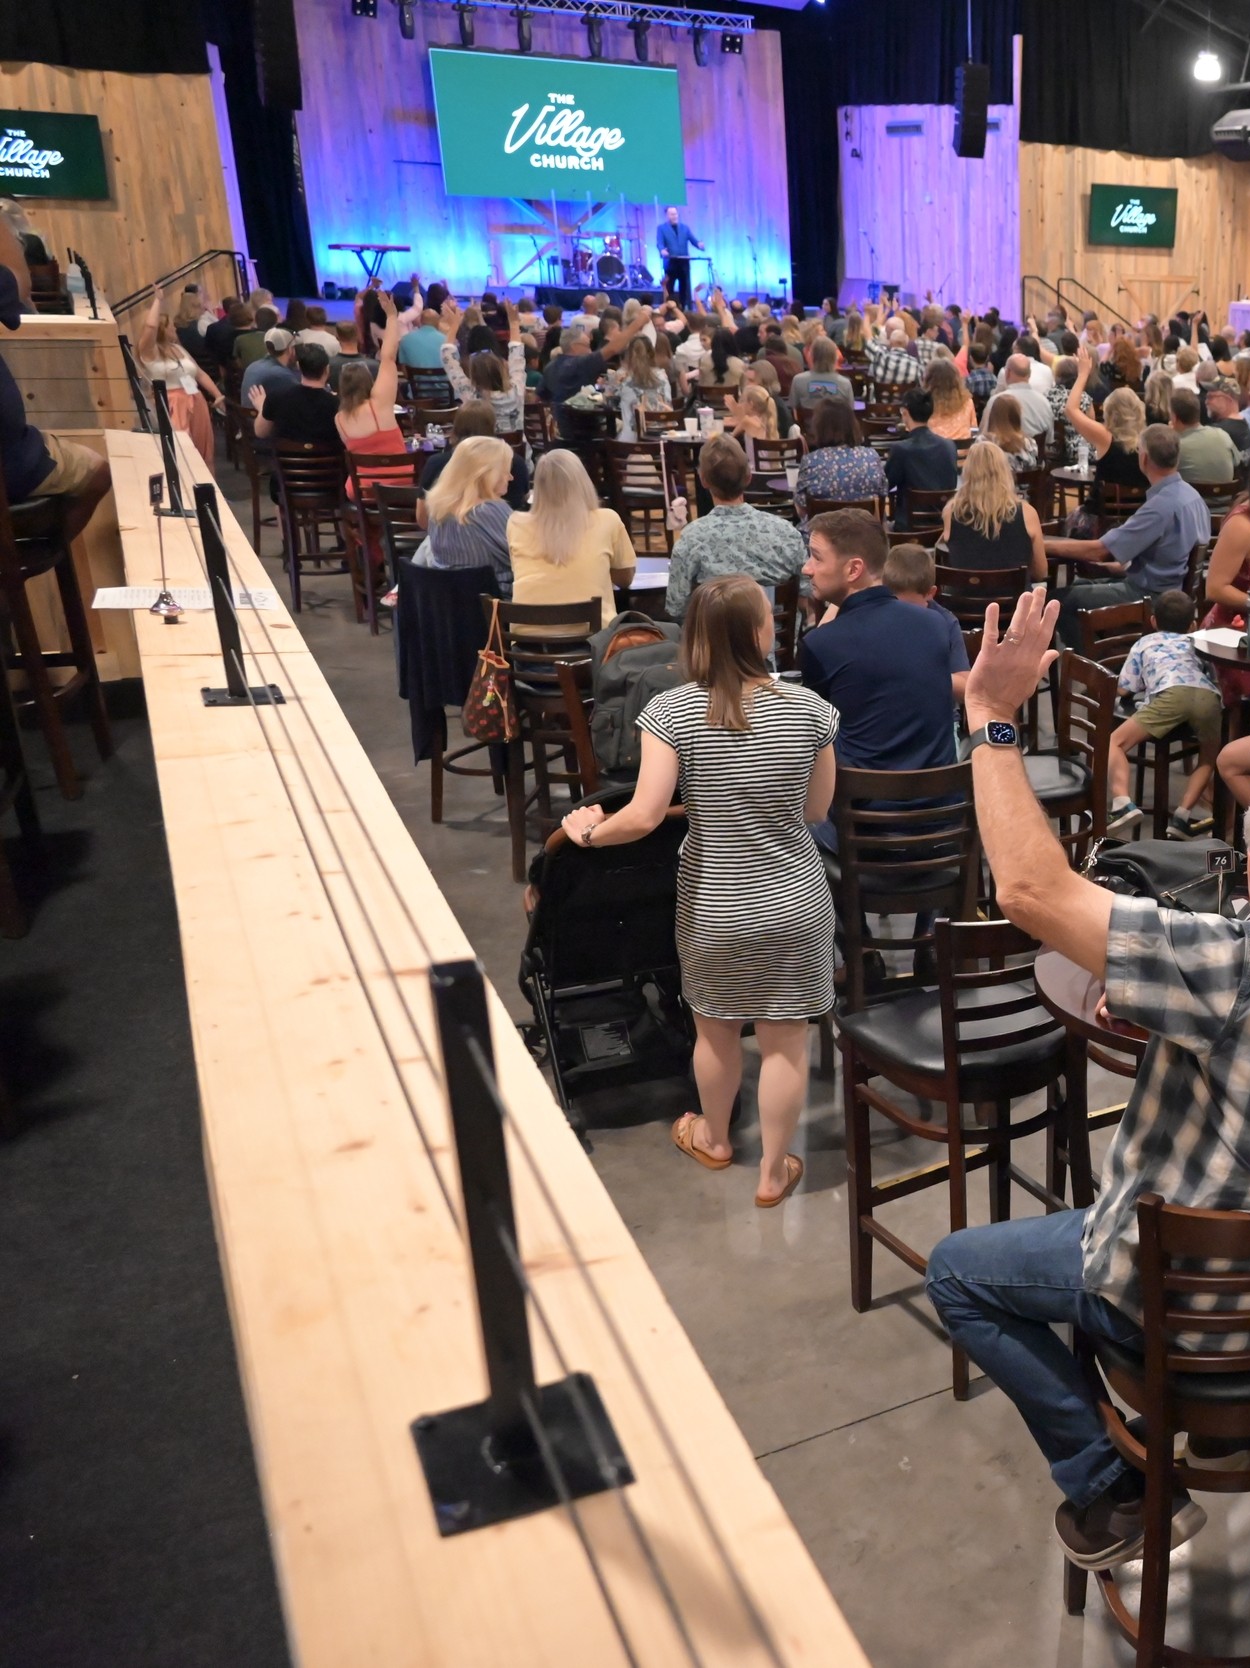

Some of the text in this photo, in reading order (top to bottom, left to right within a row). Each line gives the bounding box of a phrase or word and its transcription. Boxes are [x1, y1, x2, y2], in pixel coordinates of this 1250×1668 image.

[547, 92, 575, 105] THE
[6, 128, 27, 137] THE
[504, 103, 625, 157] Village
[530, 153, 604, 171] CHURCH
[1110, 203, 1157, 230] Village
[1214, 856, 1227, 866] 76
